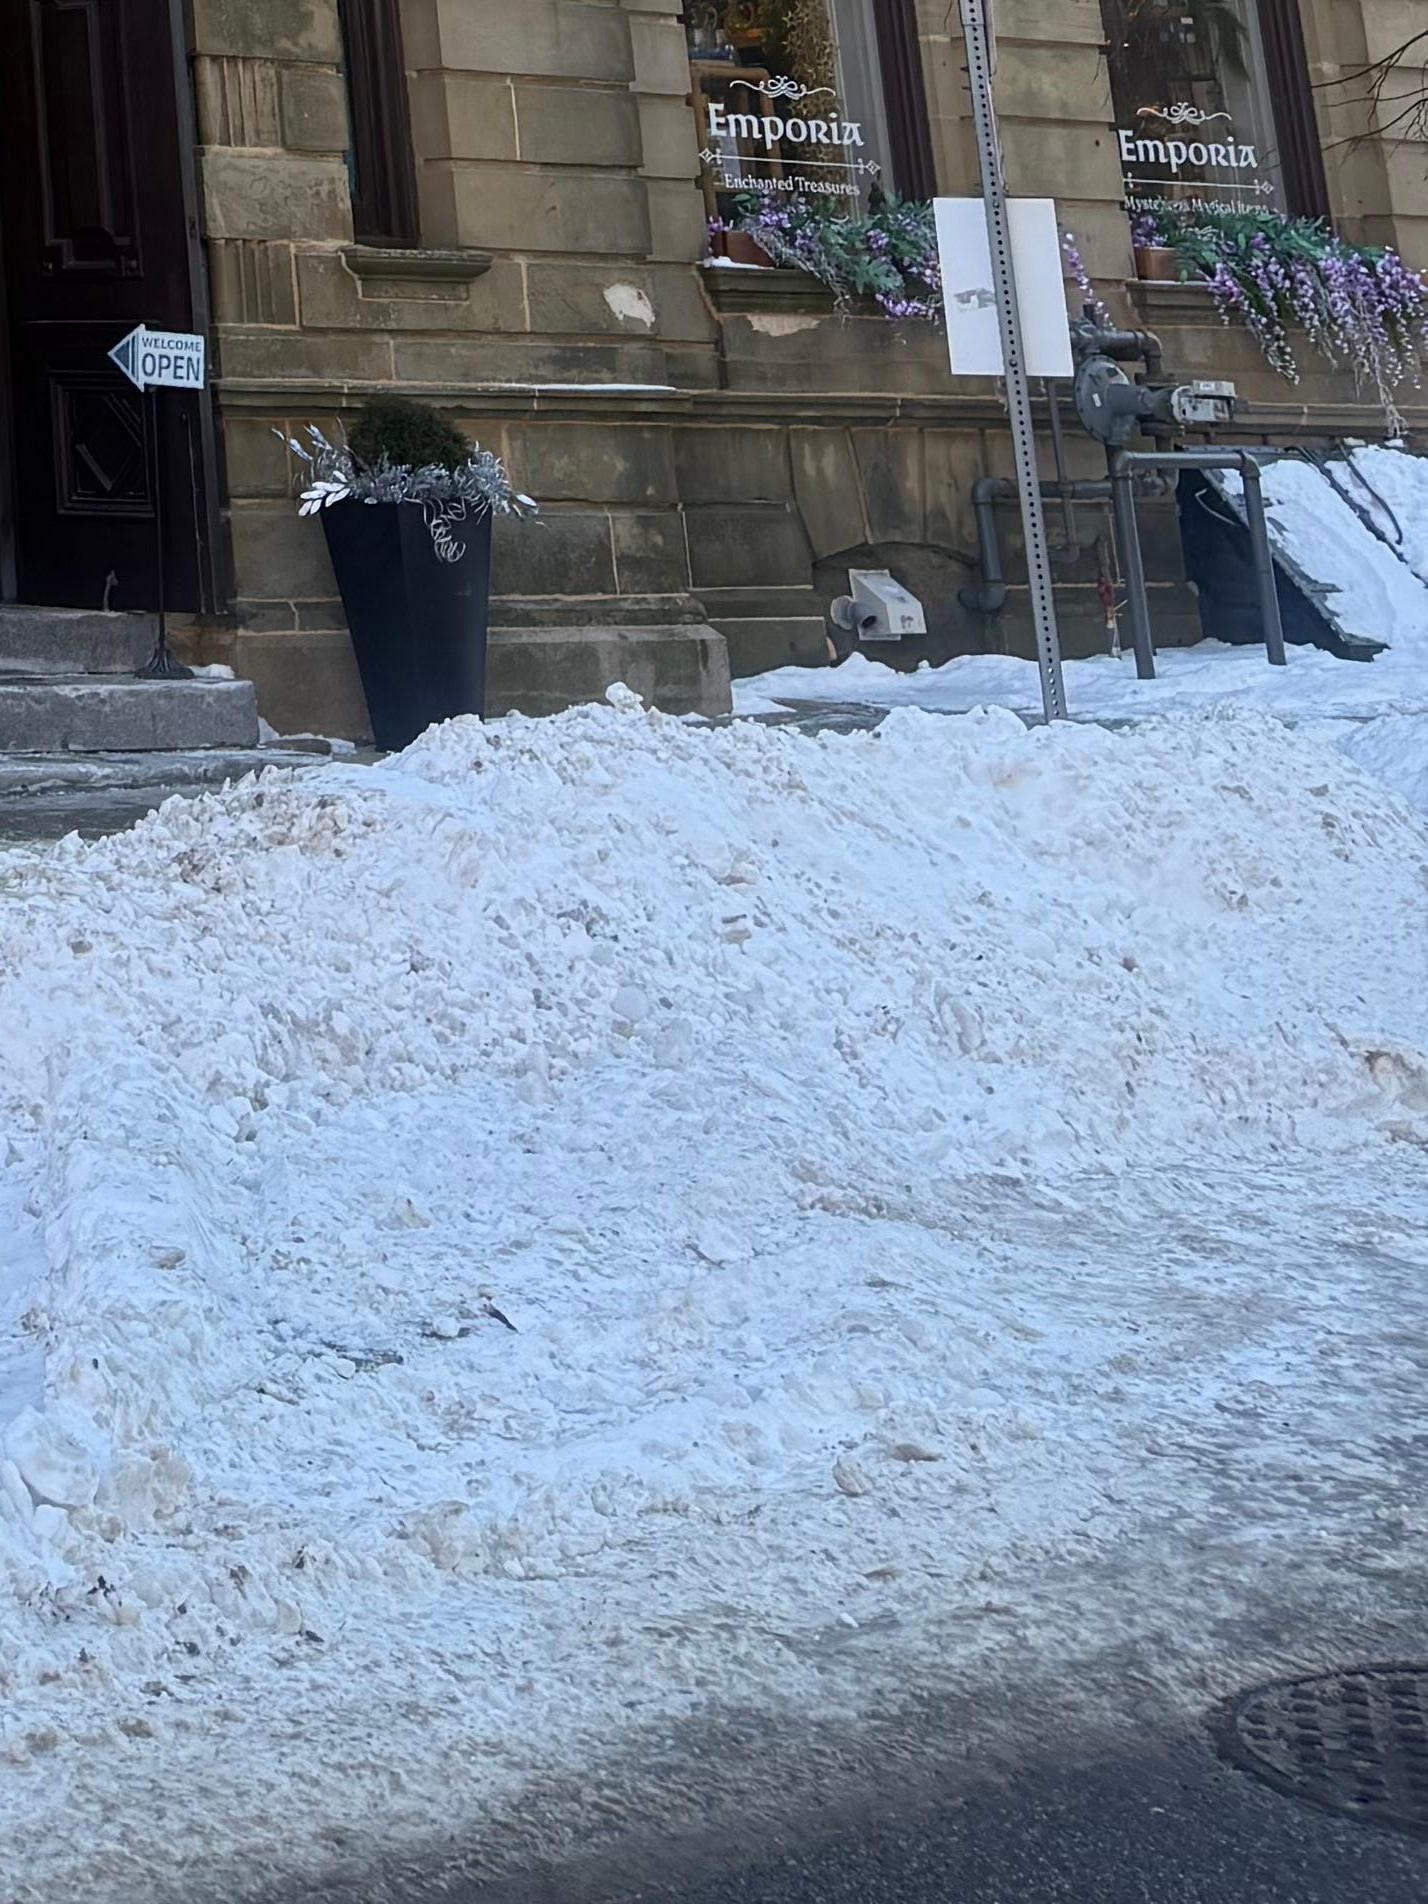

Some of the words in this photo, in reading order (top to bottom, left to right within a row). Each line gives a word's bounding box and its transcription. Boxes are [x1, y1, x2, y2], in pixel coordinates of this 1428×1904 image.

[707, 102, 864, 150] Emporia
[1117, 129, 1258, 173] Emporia
[724, 174, 794, 192] Enchanted
[794, 176, 860, 196] Treasures
[142, 337, 202, 352] WELCOME
[142, 352, 200, 382] OPEN
